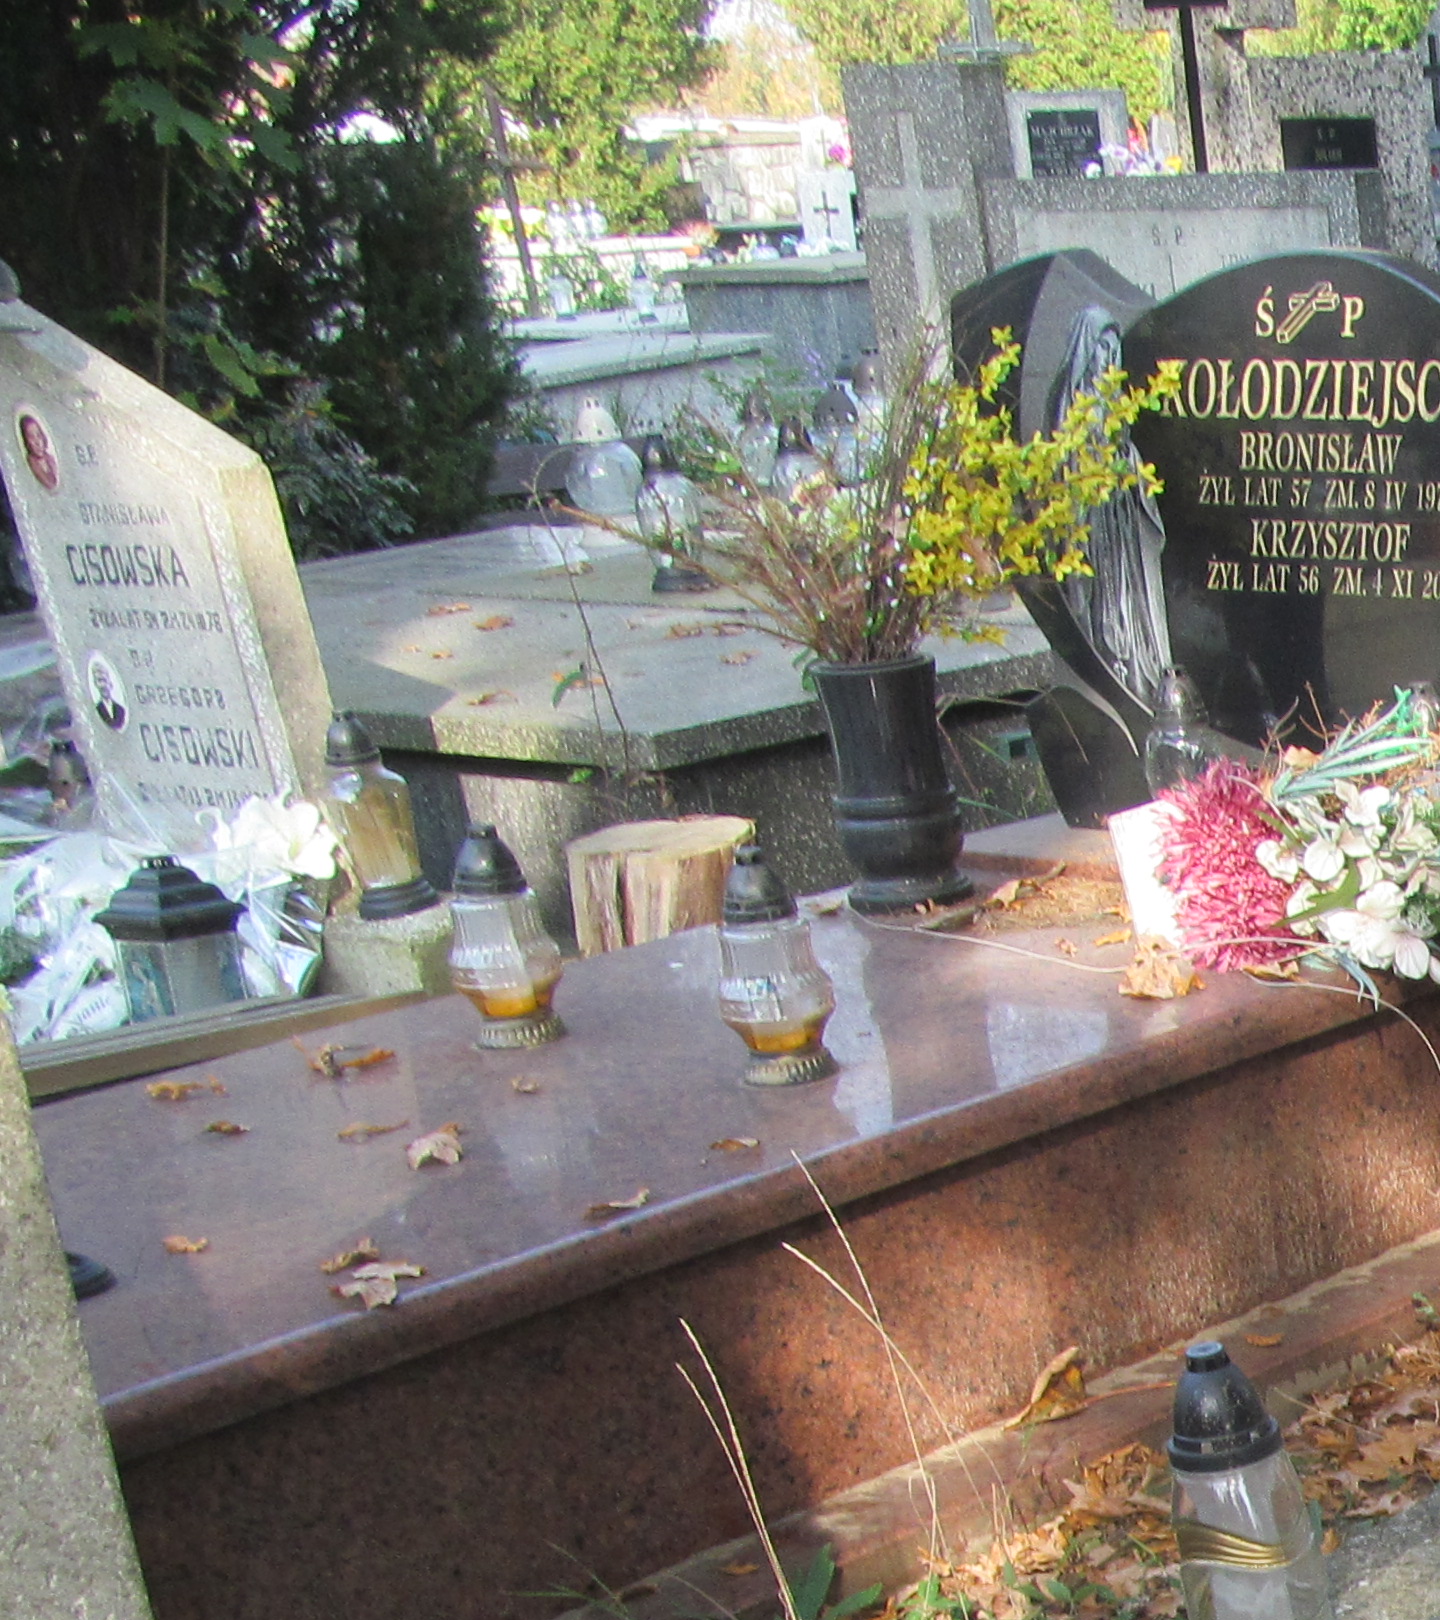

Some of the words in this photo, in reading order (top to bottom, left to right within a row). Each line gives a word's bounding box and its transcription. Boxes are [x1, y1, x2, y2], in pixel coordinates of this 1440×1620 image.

[1255, 286, 1276, 338] Ś
[1340, 297, 1364, 338] P
[1240, 431, 1403, 475] BRONISŁAW
[79, 502, 172, 526] STANISŁAWA
[1244, 477, 1282, 507] LAT
[1290, 478, 1312, 508] 57
[1324, 478, 1359, 509] ZM.
[1364, 480, 1376, 509] 8
[1384, 480, 1408, 512] IV
[1250, 518, 1411, 563] KRZYSZTOF
[66, 545, 190, 588] CISOWSKA
[1252, 562, 1291, 593] LAT
[1299, 565, 1319, 594] 56
[1333, 566, 1367, 597] ZM.
[1372, 567, 1384, 596] 4
[1391, 568, 1413, 598] XI
[139, 722, 259, 769] CISOWSKI
